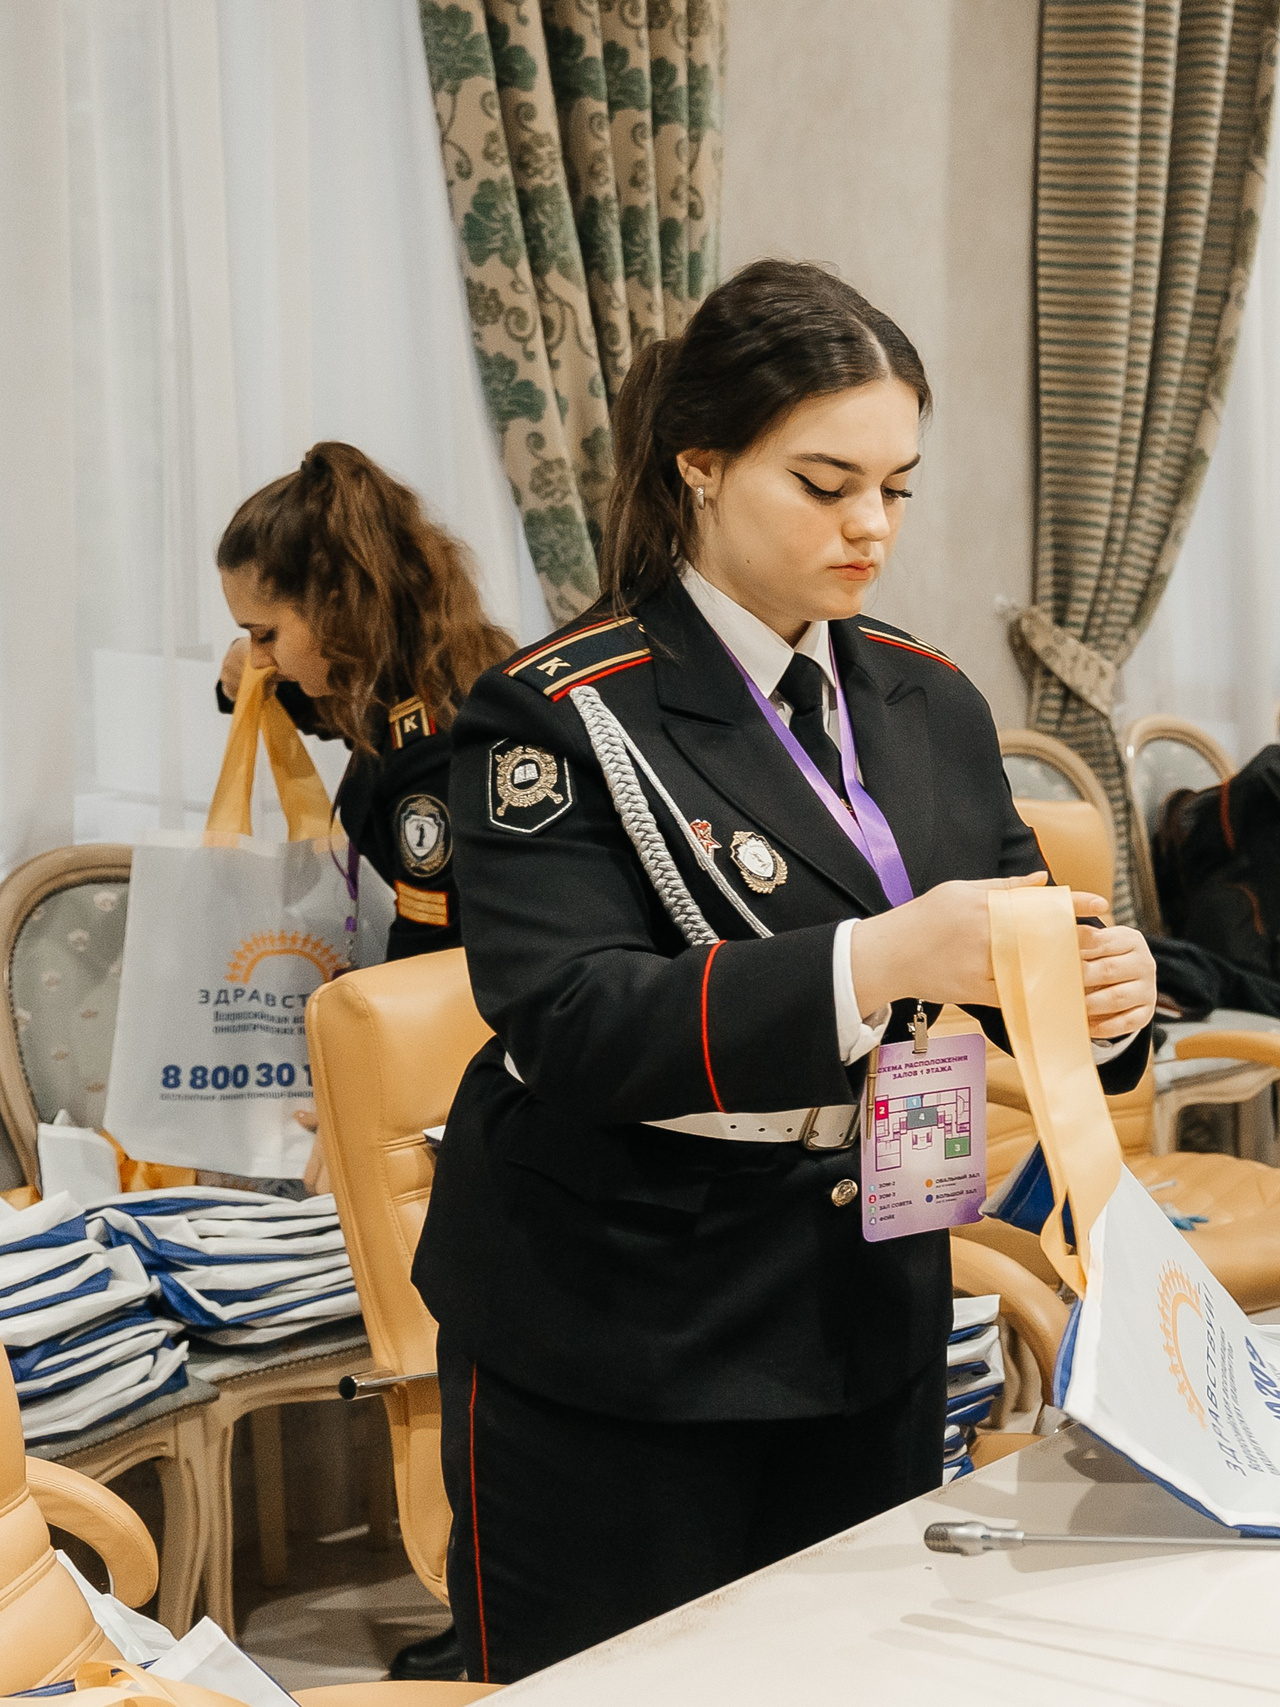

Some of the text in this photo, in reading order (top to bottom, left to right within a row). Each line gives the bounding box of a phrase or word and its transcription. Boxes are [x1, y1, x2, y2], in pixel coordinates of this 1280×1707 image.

[536, 656, 572, 677] К
[403, 715, 419, 734] К
[198, 988, 310, 1010] ЗДРАВСТ
[877, 1055, 968, 1074] СХЕМА РАСПОЛОЖЕНИЯ
[892, 1071, 918, 1080] ЗАЛОВ
[926, 1065, 953, 1076] ЭТАЖА
[162, 1064, 182, 1089] 8
[189, 1064, 249, 1090] 800
[255, 1062, 296, 1088] 30
[879, 1106, 885, 1115] 2
